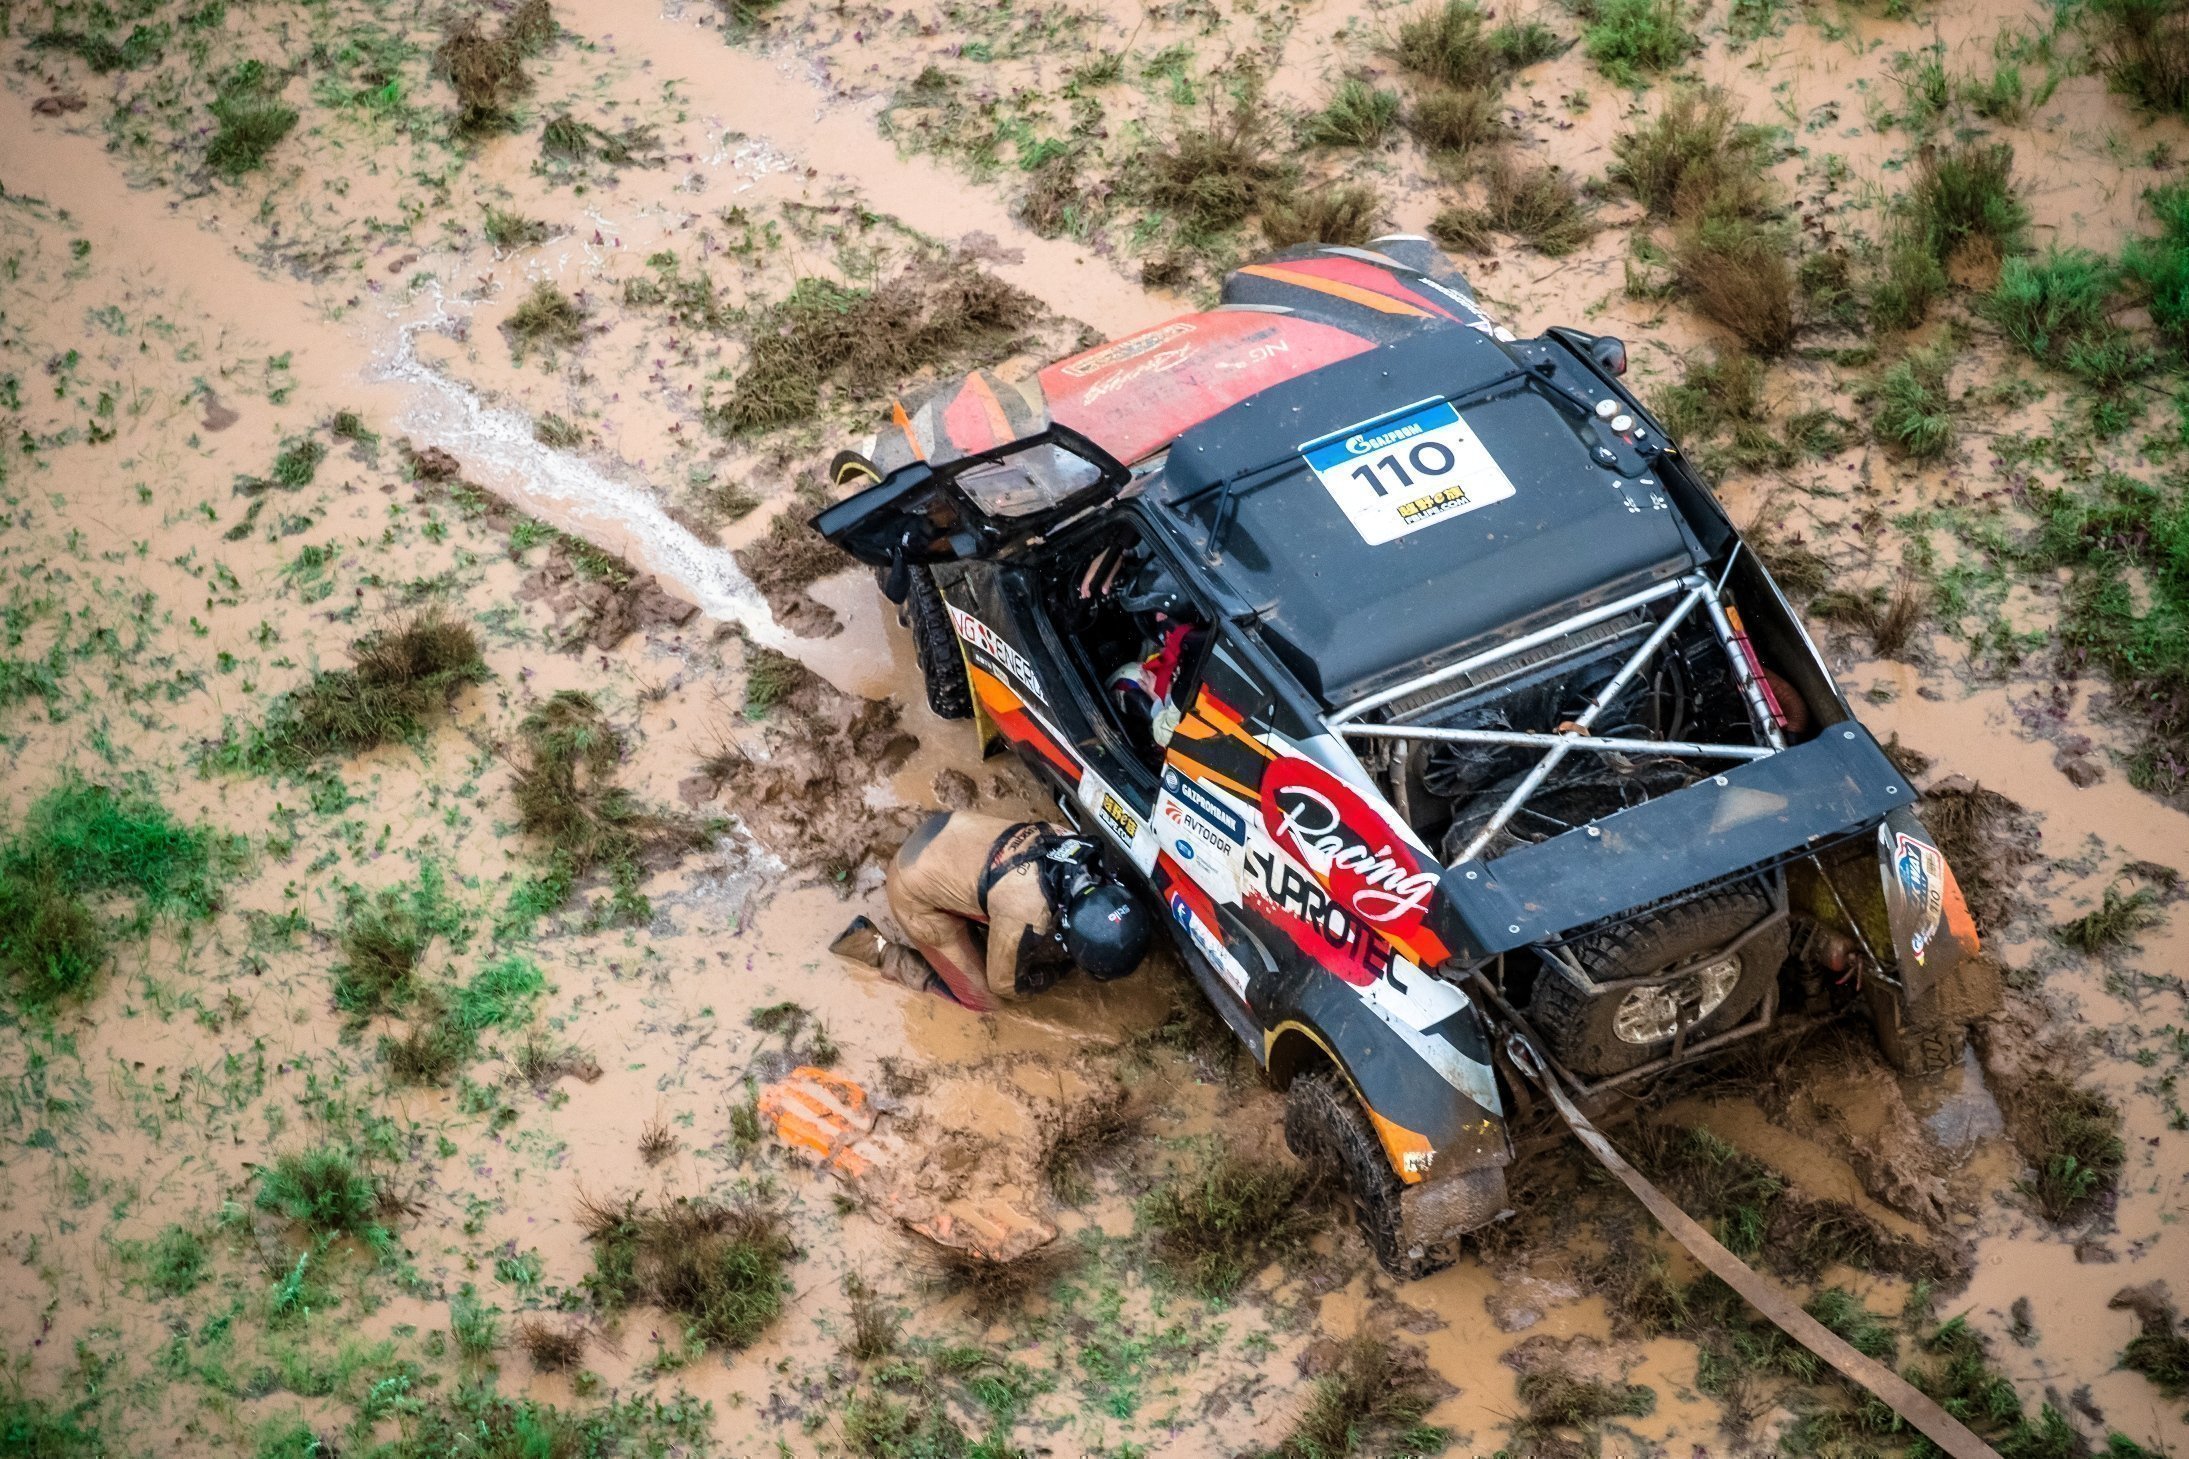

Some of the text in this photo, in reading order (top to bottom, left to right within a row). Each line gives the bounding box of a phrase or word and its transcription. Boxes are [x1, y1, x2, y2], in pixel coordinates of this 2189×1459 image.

[1351, 441, 1455, 497] 110
[1181, 783, 1236, 832] GAZPROMBANK
[1184, 814, 1232, 856] AVTODOR
[1276, 785, 1441, 921] Racing
[1244, 850, 1408, 995] SUPROTEC
